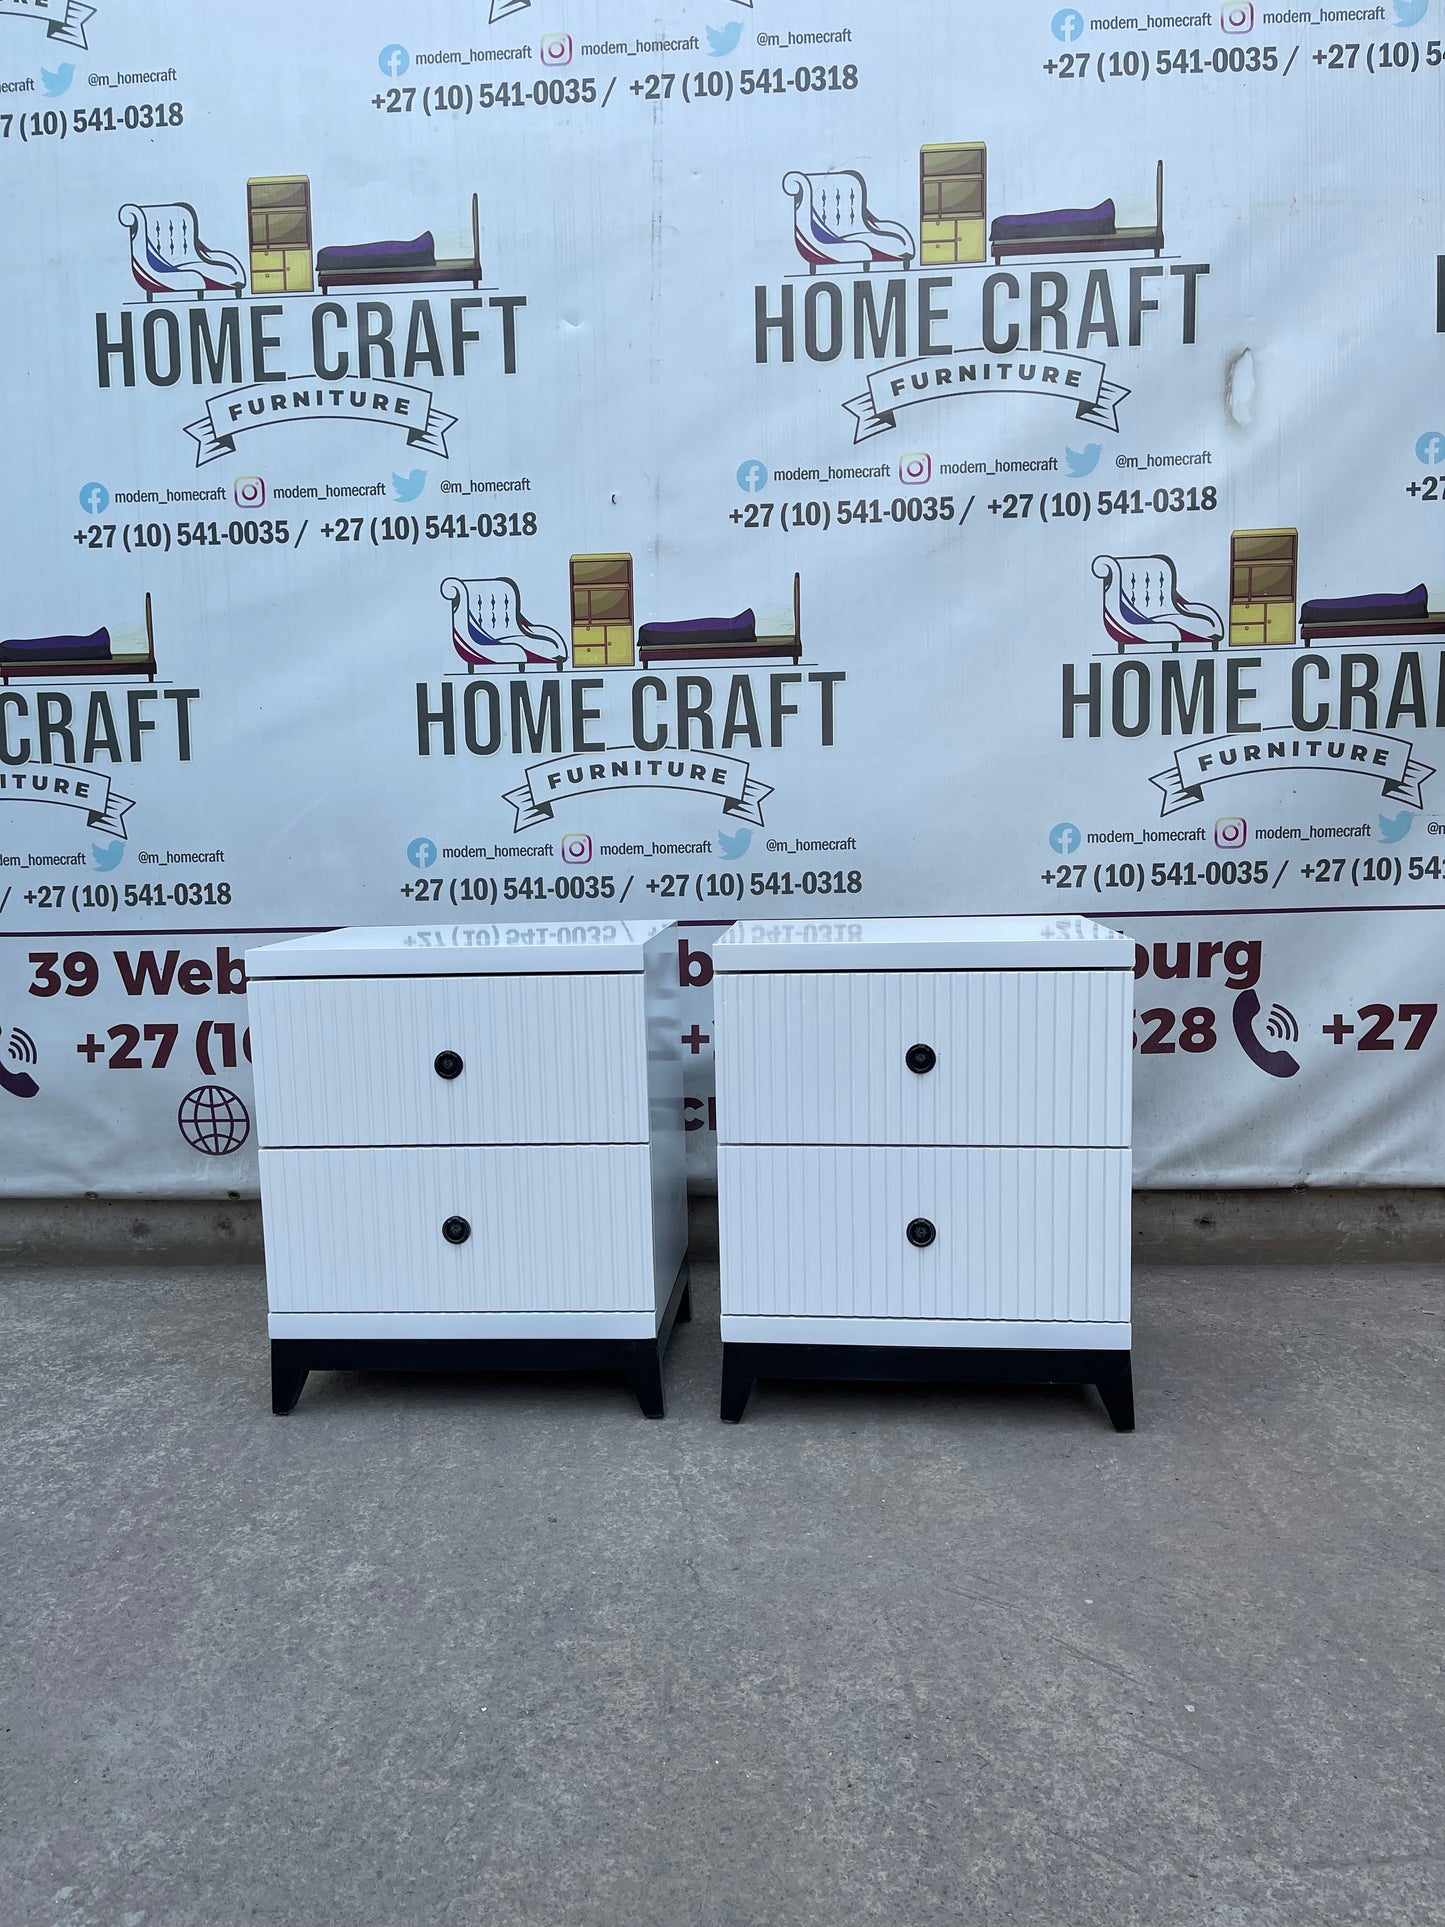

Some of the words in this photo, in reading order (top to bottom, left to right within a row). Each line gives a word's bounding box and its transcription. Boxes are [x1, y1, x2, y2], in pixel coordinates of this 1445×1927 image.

[757, 28, 852, 48] @m_homecraft
[88, 68, 177, 87] @m_homecraft
[1043, 53, 1090, 78] +27
[1098, 51, 1149, 82] (10)
[1156, 47, 1278, 74] 541-0035
[1313, 44, 1360, 69] +27
[1367, 42, 1419, 73] (10)
[1426, 41, 1445, 65] 5
[372, 88, 416, 112] +27
[423, 85, 472, 116] (10)
[480, 78, 596, 108] 541-0035
[630, 74, 675, 99] +27
[683, 71, 733, 103] (10)
[740, 65, 858, 94] 541-0318
[20, 111, 67, 142] (10)
[73, 103, 183, 132] 541-0318
[755, 278, 952, 364] HOME
[983, 265, 1210, 354] CRAFT
[96, 306, 286, 388] HOME
[312, 297, 526, 380] CRAFT
[891, 362, 1082, 397] FURNITURE
[228, 389, 411, 421] FURNITURE
[1116, 451, 1211, 470] @m_homecraft
[441, 478, 530, 495] @m_homecraft
[729, 504, 774, 527] +27
[781, 502, 830, 532] (10)
[837, 496, 954, 524] 541-0035
[988, 494, 1033, 518] +27
[1040, 492, 1090, 522] (10)
[1097, 486, 1217, 515] 541-0318
[74, 525, 116, 548] +27
[123, 524, 171, 552] (10)
[177, 520, 289, 546] 541-0035
[321, 518, 363, 541] +27
[371, 516, 419, 546] (10)
[426, 512, 537, 539] 541-0318
[1063, 658, 1261, 738] HOME
[1292, 652, 1445, 731] CRA
[0, 689, 200, 765] CRAFT
[417, 679, 605, 756] HOME
[632, 672, 845, 751] CRAFT
[1198, 740, 1389, 772] FURNITURE
[547, 760, 728, 789] FURNITURE
[139, 850, 224, 865] @m_homecraft
[767, 837, 856, 853] @m_homecraft
[401, 879, 443, 901] +27
[450, 878, 497, 906] (10)
[504, 876, 615, 900] 541-0035
[646, 875, 689, 897] +27
[696, 873, 743, 901] (10)
[750, 871, 862, 895] 541-0318
[1041, 865, 1087, 888] +27
[1094, 864, 1144, 892] (10)
[1151, 861, 1268, 886] 541-0035
[1301, 859, 1346, 882] +27
[1352, 857, 1401, 886] (10)
[1408, 856, 1445, 880] 54
[24, 886, 65, 907] +27
[72, 885, 118, 912] (10)
[125, 883, 231, 906] 541-0318
[29, 952, 98, 997] 39
[77, 1024, 178, 1069] +27
[1133, 1007, 1216, 1054] 28
[1323, 1004, 1437, 1050] +27
